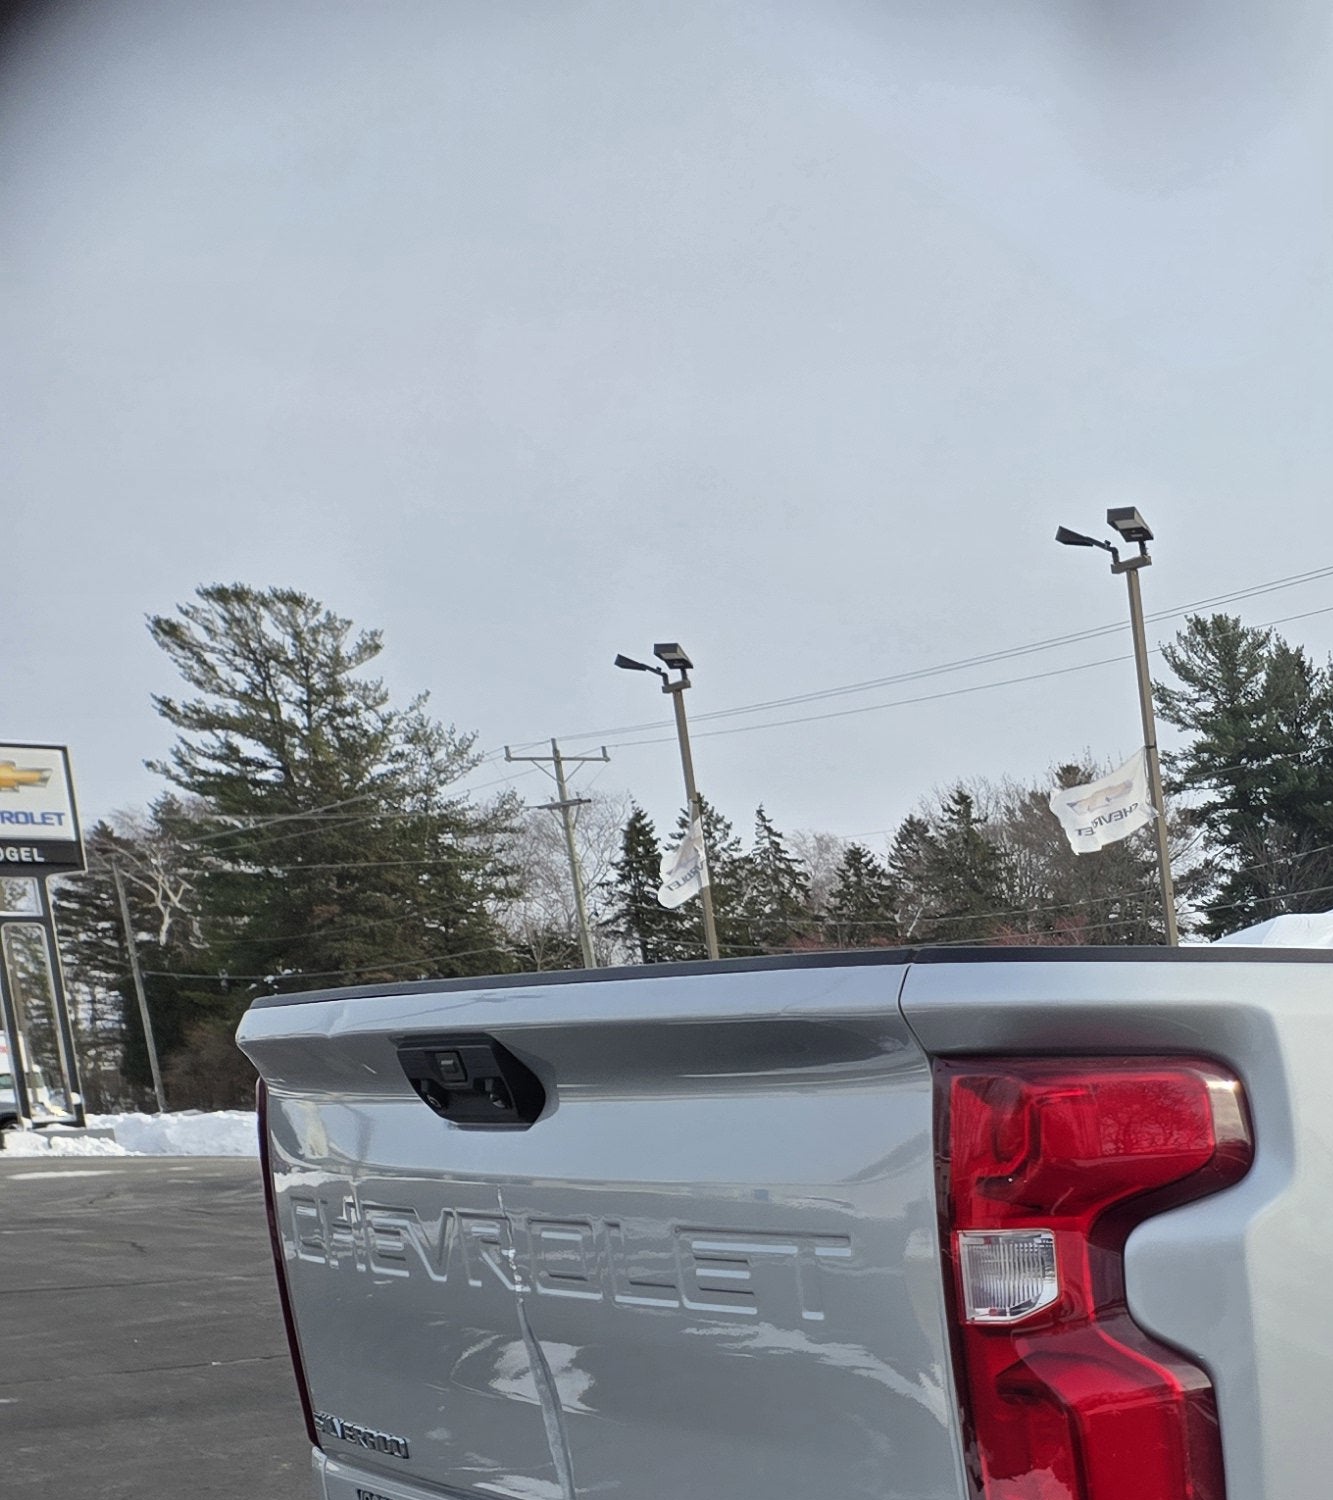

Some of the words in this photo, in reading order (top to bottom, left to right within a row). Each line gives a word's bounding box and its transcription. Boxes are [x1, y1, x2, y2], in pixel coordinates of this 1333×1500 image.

[0, 810, 65, 826] ROLET
[0, 846, 45, 863] GEL
[290, 1195, 852, 1321] CHEVROLET
